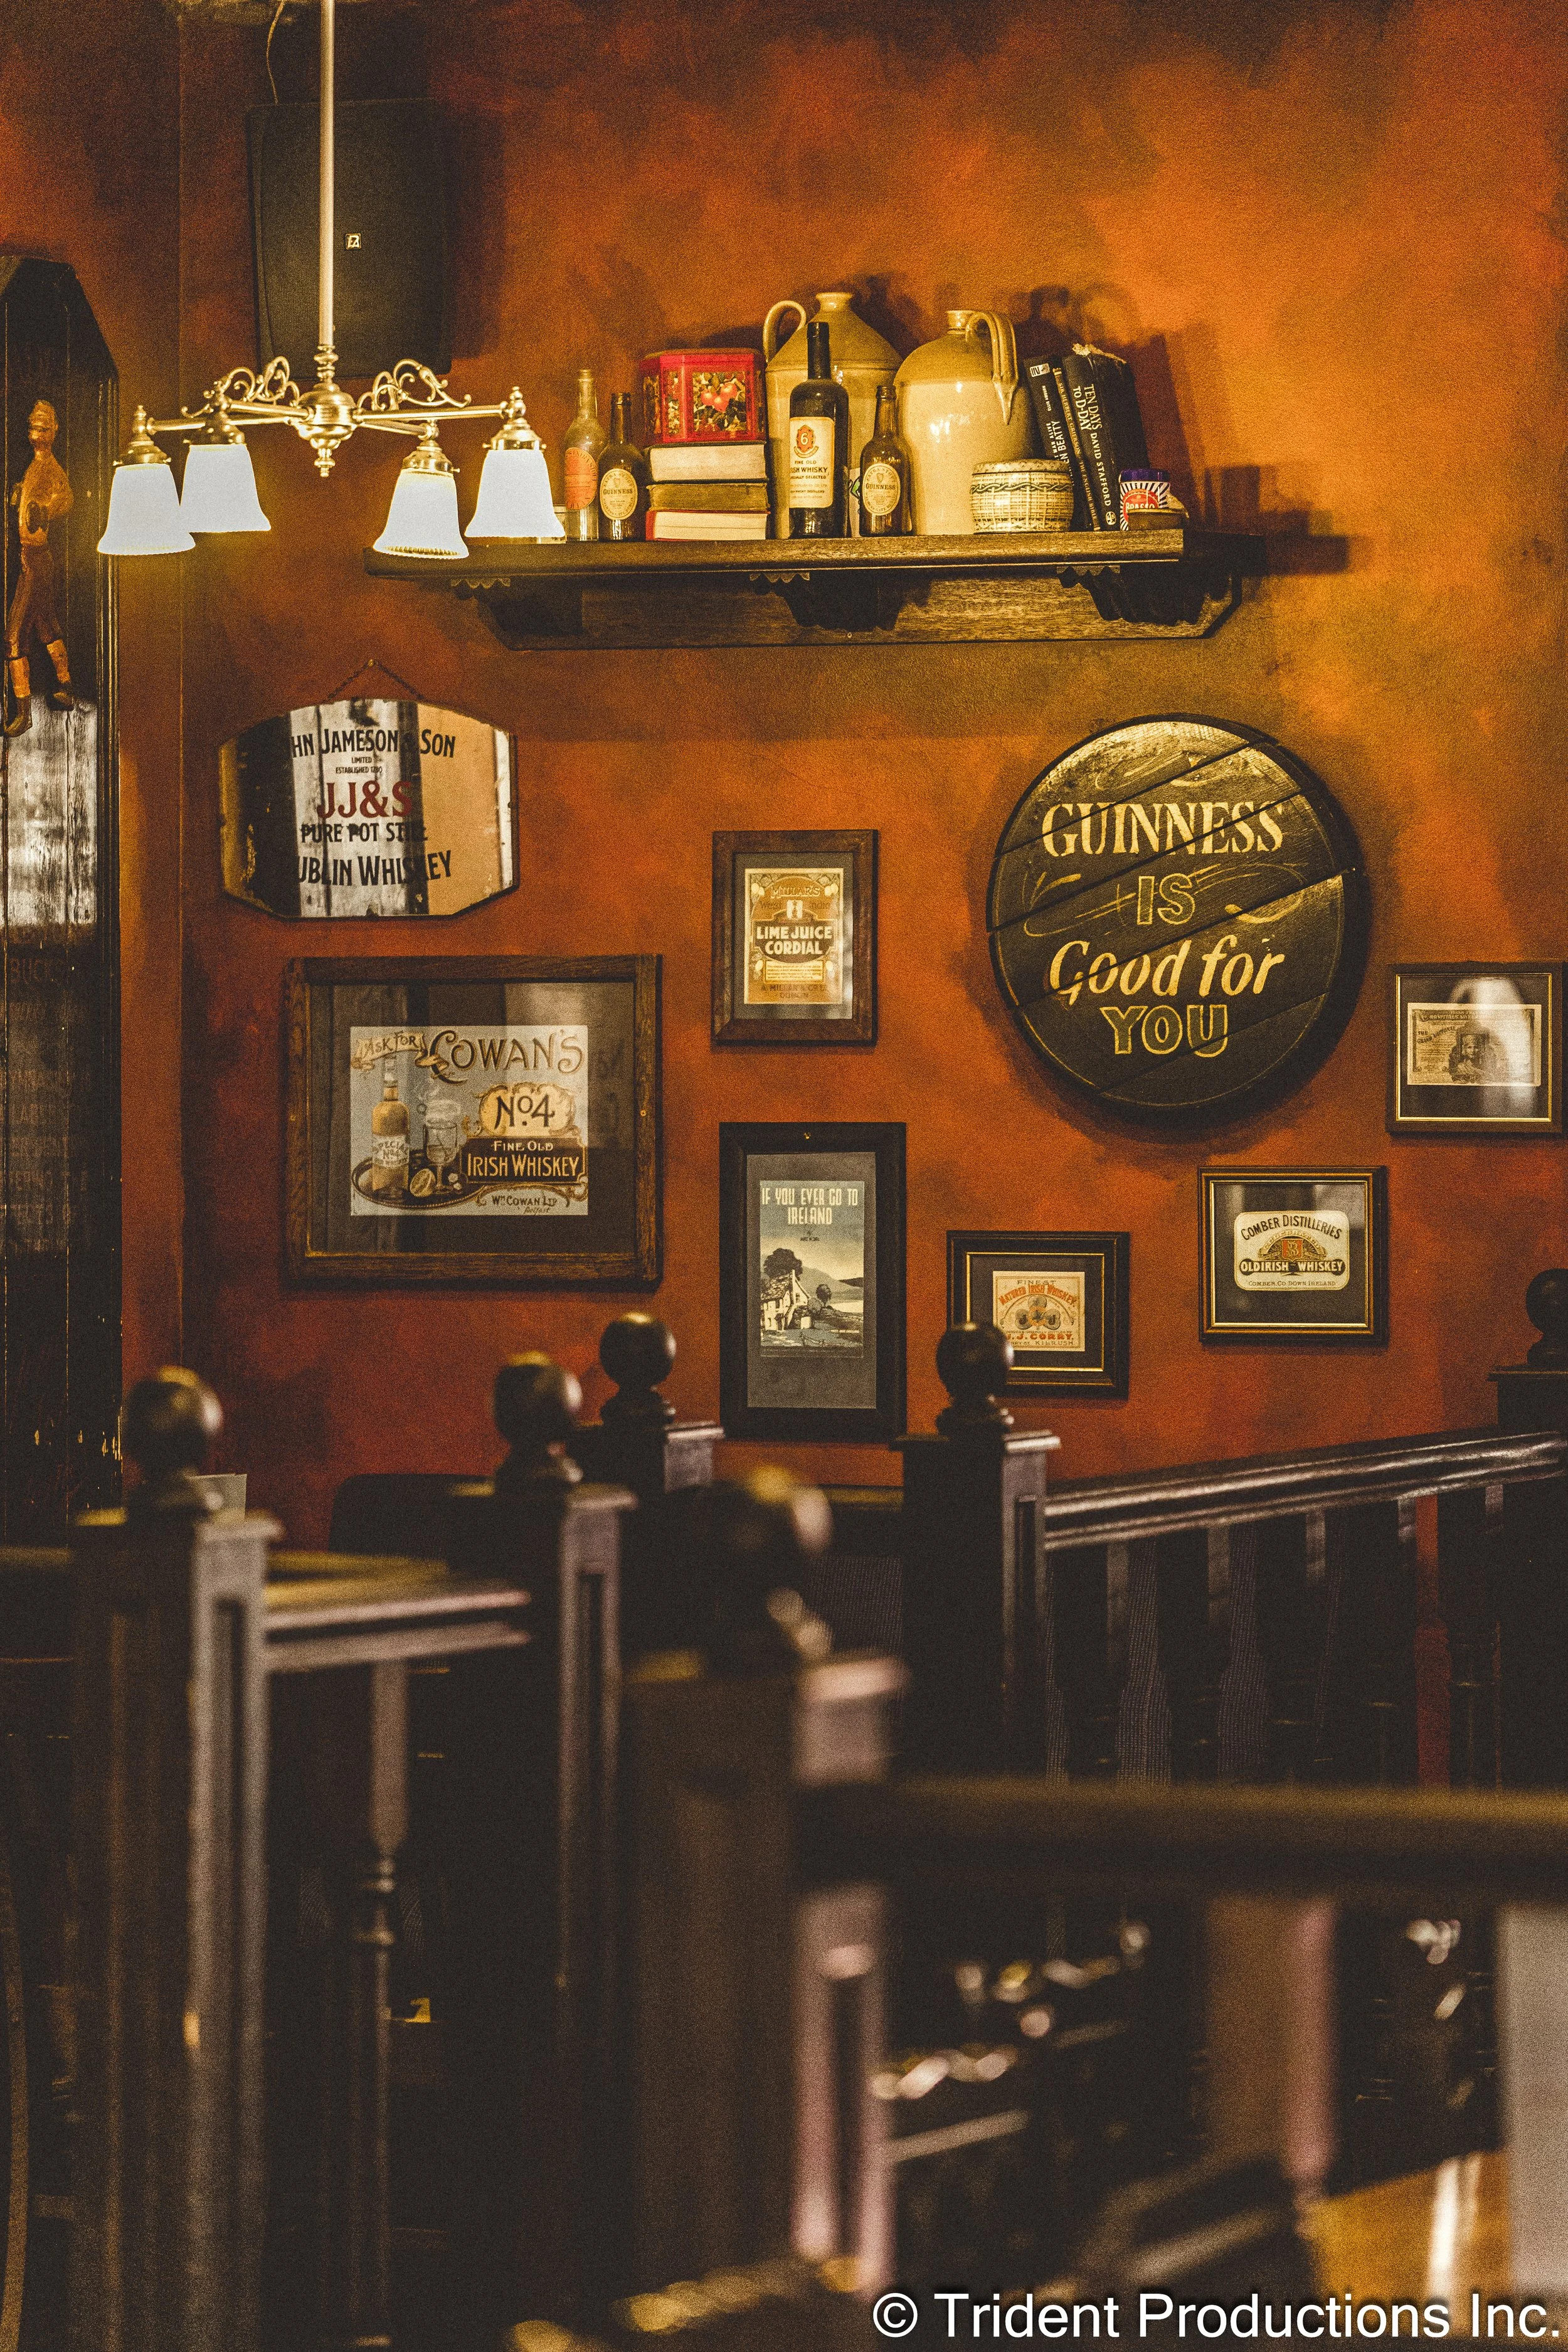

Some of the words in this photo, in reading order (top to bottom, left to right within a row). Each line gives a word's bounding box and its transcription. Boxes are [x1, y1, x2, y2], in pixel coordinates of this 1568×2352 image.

[1073, 386, 1083, 398] TO
[1084, 383, 1097, 405] TEN
[1075, 400, 1092, 431] D-DAY
[1088, 405, 1103, 430] DAYS
[800, 432, 808, 445] 6
[1046, 422, 1054, 438] ALIVE
[1051, 421, 1067, 451] BEATTY
[1090, 432, 1102, 459] DAVID
[1096, 462, 1112, 506] STAFFORD
[291, 733, 315, 758] HN
[320, 728, 399, 755] JAMESON
[419, 729, 457, 758] SON
[335, 766, 369, 775] ESTABLISHED
[316, 780, 413, 819] JJ&S
[299, 822, 342, 844] PURE
[346, 822, 379, 842] POT
[1041, 800, 1285, 858] GUINNESS
[297, 856, 352, 886] UBLIN
[1135, 872, 1196, 926] IS
[756, 926, 789, 940] LIME
[790, 926, 834, 940] JUICE
[764, 941, 824, 955] CORDIAL
[1049, 939, 1192, 1007] Good
[1198, 933, 1286, 998] for
[365, 1037, 393, 1056] ASK
[393, 1030, 418, 1052] FOR
[1100, 1003, 1229, 1059] YOU
[429, 1029, 586, 1084] COWAN'S
[491, 1140, 525, 1152] FINE
[527, 1140, 554, 1152] OLD
[467, 1153, 509, 1177] IRISH
[511, 1153, 580, 1177] WHISKEY
[506, 1195, 541, 1206] COWAN
[761, 1187, 771, 1205] IF
[775, 1187, 795, 1205] YOU
[800, 1188, 825, 1206] EVER
[829, 1188, 842, 1206] GO
[847, 1188, 859, 1206] TO
[787, 1207, 832, 1225] IRELAND
[1241, 1217, 1281, 1241] COMBER
[1283, 1214, 1342, 1239] DISTILLERIES
[1297, 1261, 1343, 1272] WHISKEY
[1028, 1284, 1046, 1294] IRISH
